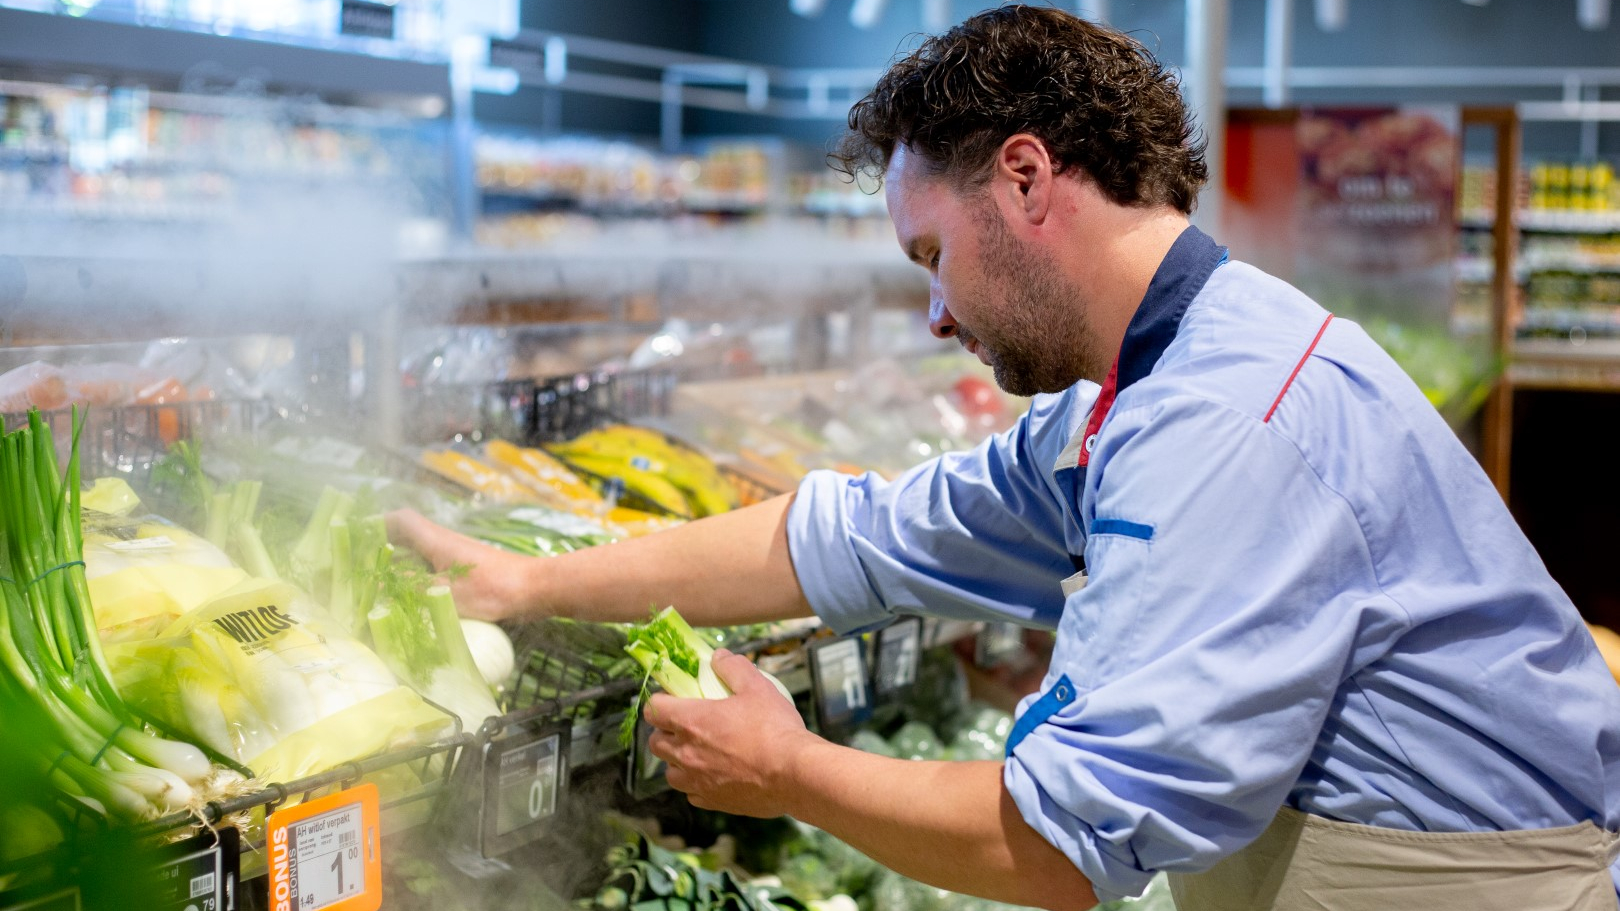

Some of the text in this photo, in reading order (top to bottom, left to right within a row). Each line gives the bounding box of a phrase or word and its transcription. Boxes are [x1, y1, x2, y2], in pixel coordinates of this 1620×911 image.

[212, 605, 299, 643] WITLOF
[296, 825, 307, 838] AH
[308, 819, 326, 834] witlof
[326, 813, 350, 828] verpakt
[273, 826, 291, 911] BONUS
[348, 847, 358, 860] 00
[289, 848, 298, 898] BONUS
[203, 897, 215, 911] 79
